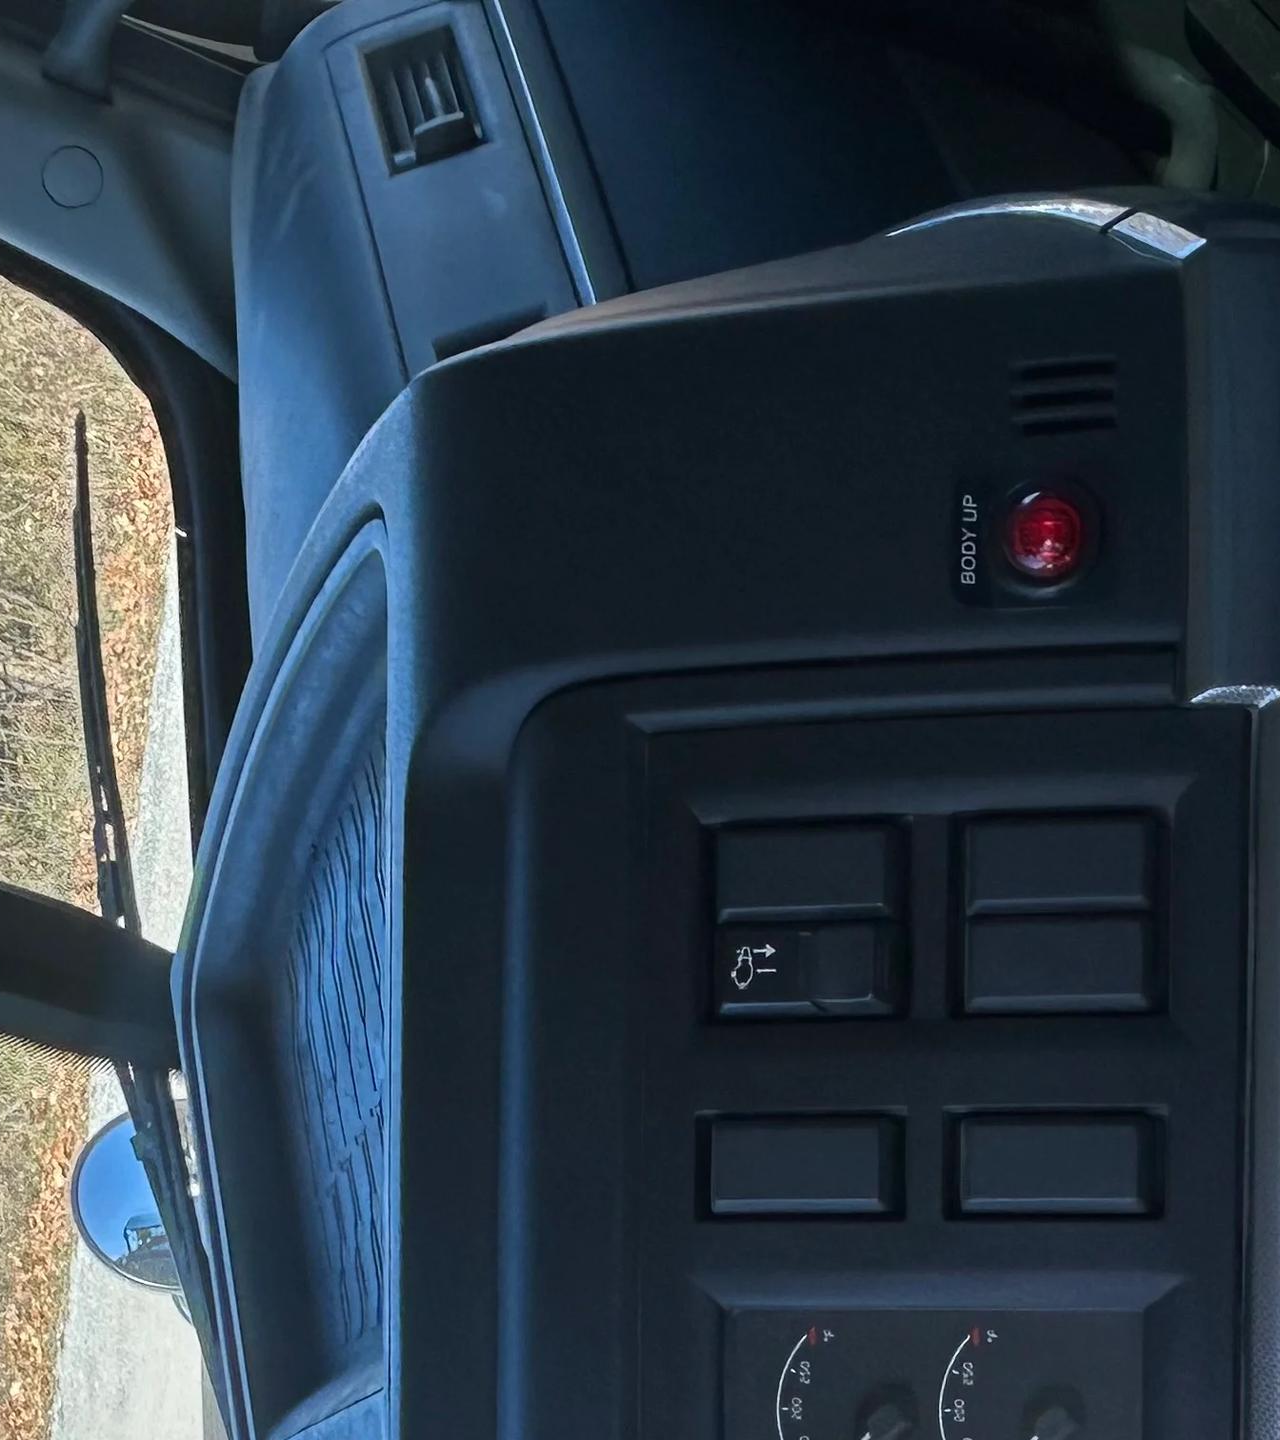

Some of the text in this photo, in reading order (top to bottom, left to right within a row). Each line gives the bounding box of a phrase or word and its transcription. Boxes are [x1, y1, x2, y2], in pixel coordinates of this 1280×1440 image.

[960, 494, 978, 585] BODY UP
[791, 1397, 803, 1420] 200
[799, 1361, 811, 1384] 250
[953, 1398, 965, 1422] 200
[962, 1362, 974, 1385] 250
